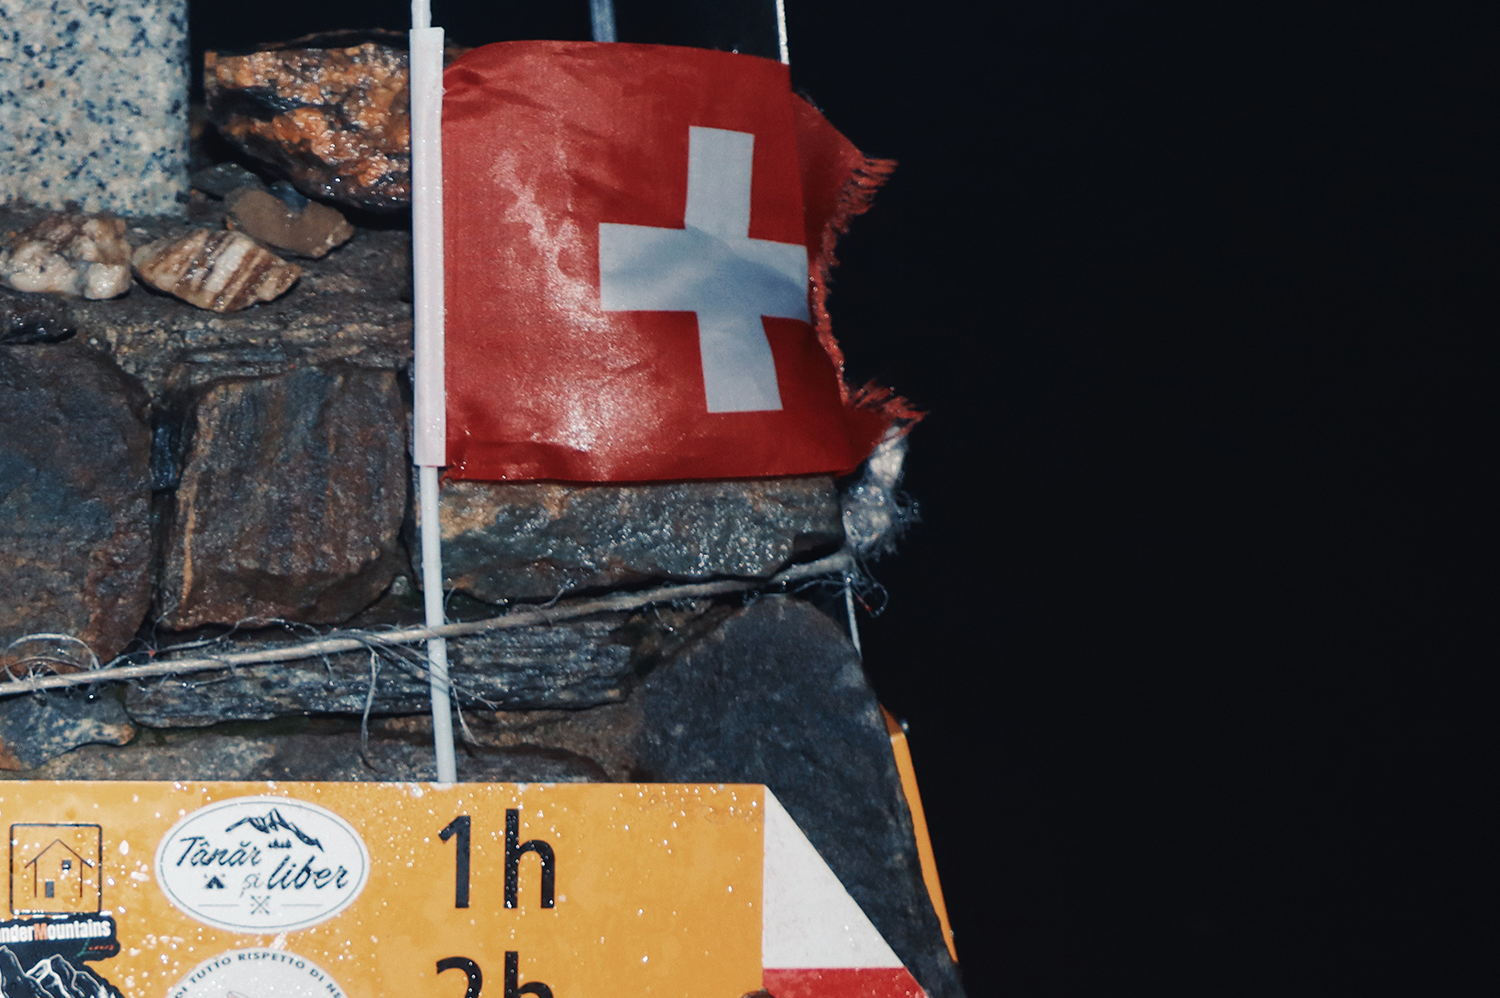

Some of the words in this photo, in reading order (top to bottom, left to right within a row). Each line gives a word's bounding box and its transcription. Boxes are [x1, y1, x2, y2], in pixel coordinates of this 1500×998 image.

[175, 836, 262, 867] Tânăr
[438, 808, 556, 910] 1h
[266, 854, 349, 890] liber
[189, 956, 232, 984] TUTTO
[238, 951, 306, 970] RISPETTO
[309, 967, 325, 983] DI
